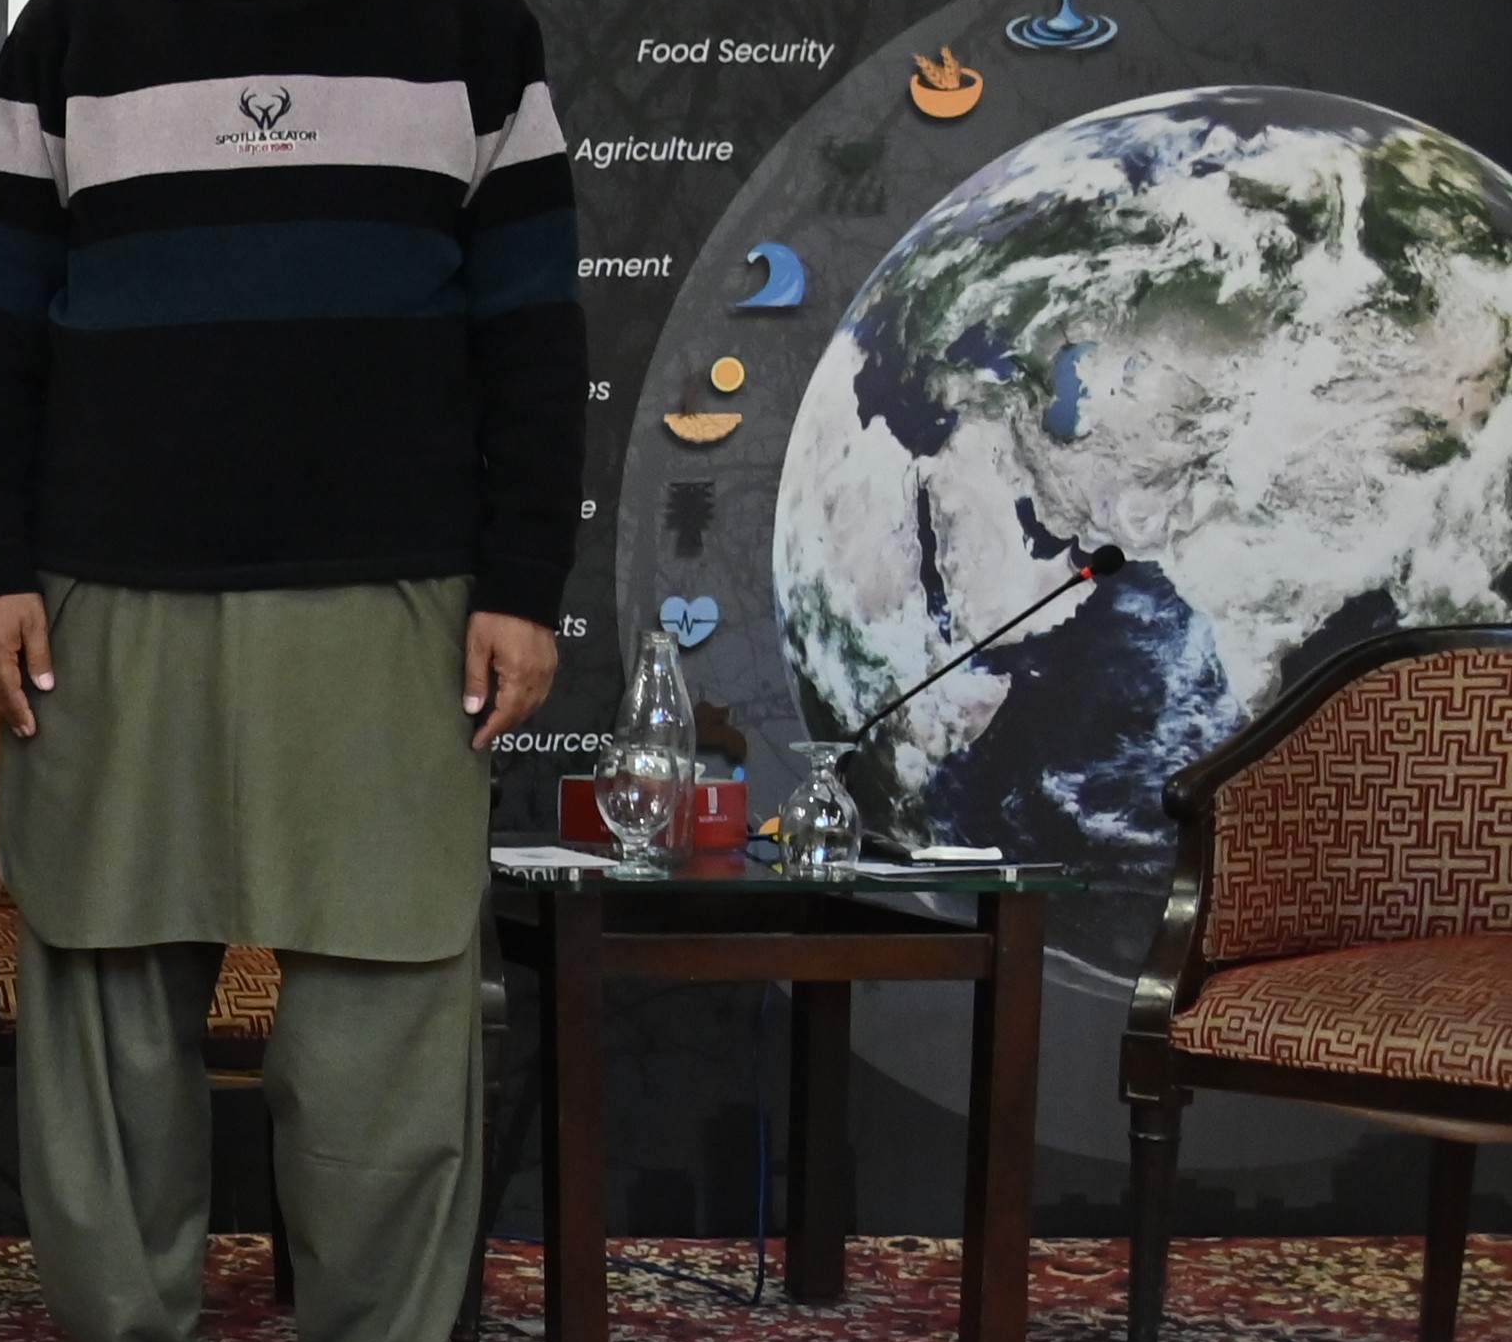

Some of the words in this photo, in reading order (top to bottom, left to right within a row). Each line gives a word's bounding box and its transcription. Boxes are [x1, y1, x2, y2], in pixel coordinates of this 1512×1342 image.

[637, 38, 711, 64] Food
[718, 37, 835, 70] Security
[574, 135, 734, 169] Agriculture
[577, 253, 672, 277] ement
[491, 732, 614, 752] esources
